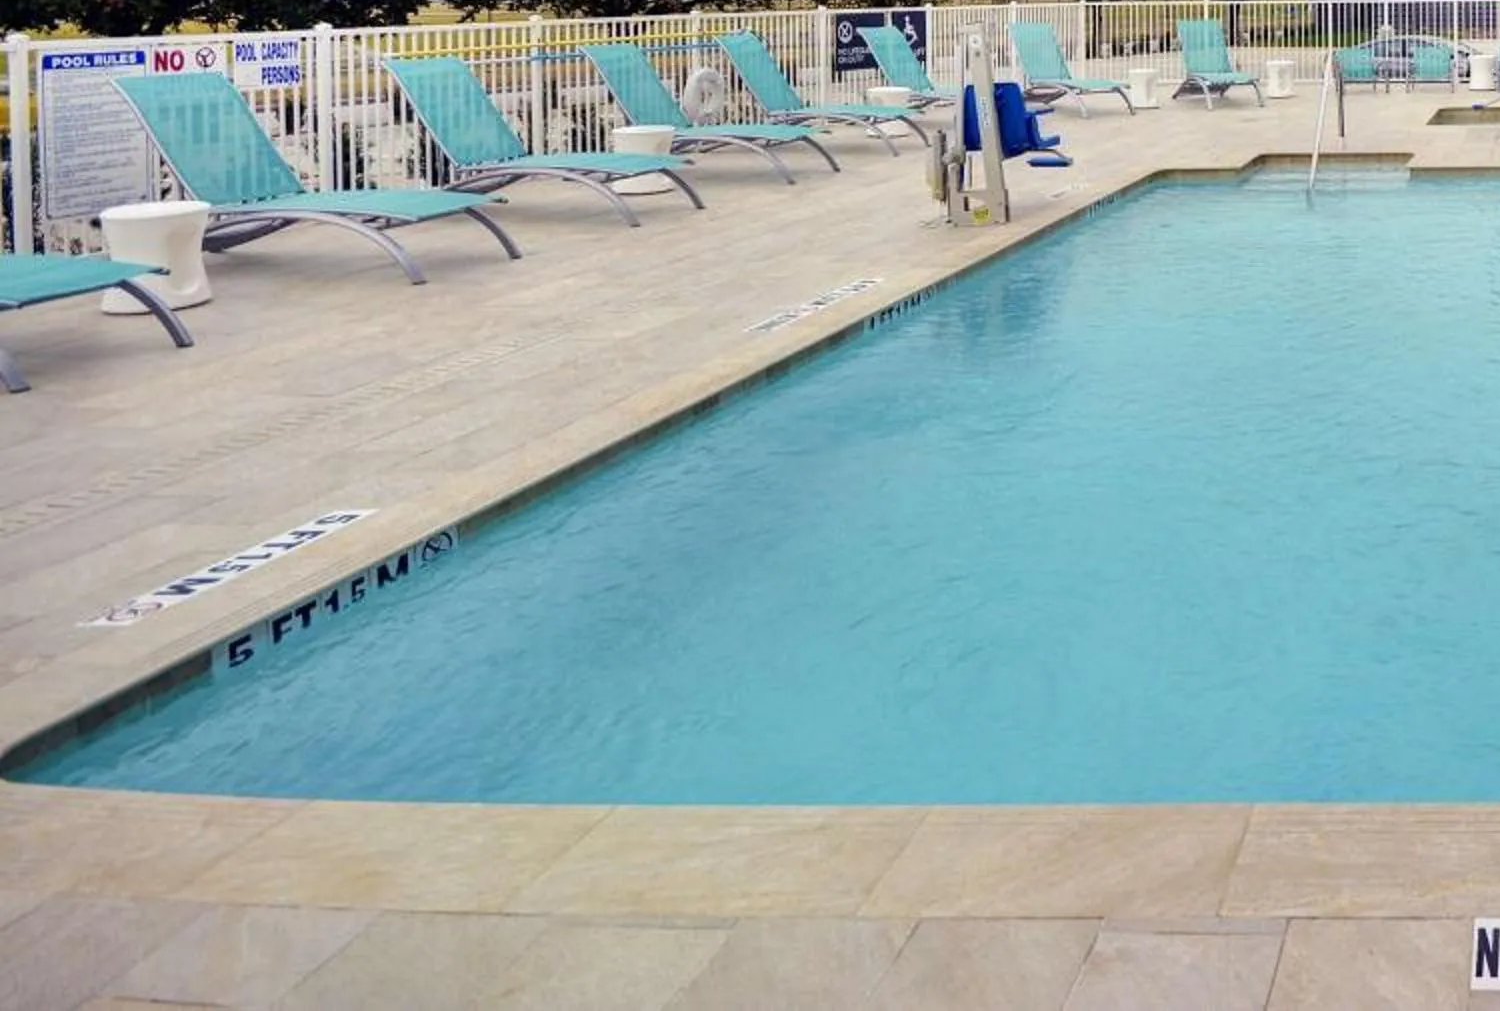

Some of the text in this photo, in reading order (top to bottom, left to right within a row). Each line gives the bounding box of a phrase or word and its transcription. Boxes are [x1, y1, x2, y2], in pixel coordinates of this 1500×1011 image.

[51, 51, 137, 68] POOL RULES
[153, 49, 185, 72] NO
[235, 41, 299, 62] POOL CAPACITY
[261, 65, 300, 85] PERSONS
[263, 529, 326, 550] FT
[228, 553, 410, 669] 5 FT 1.5 M
